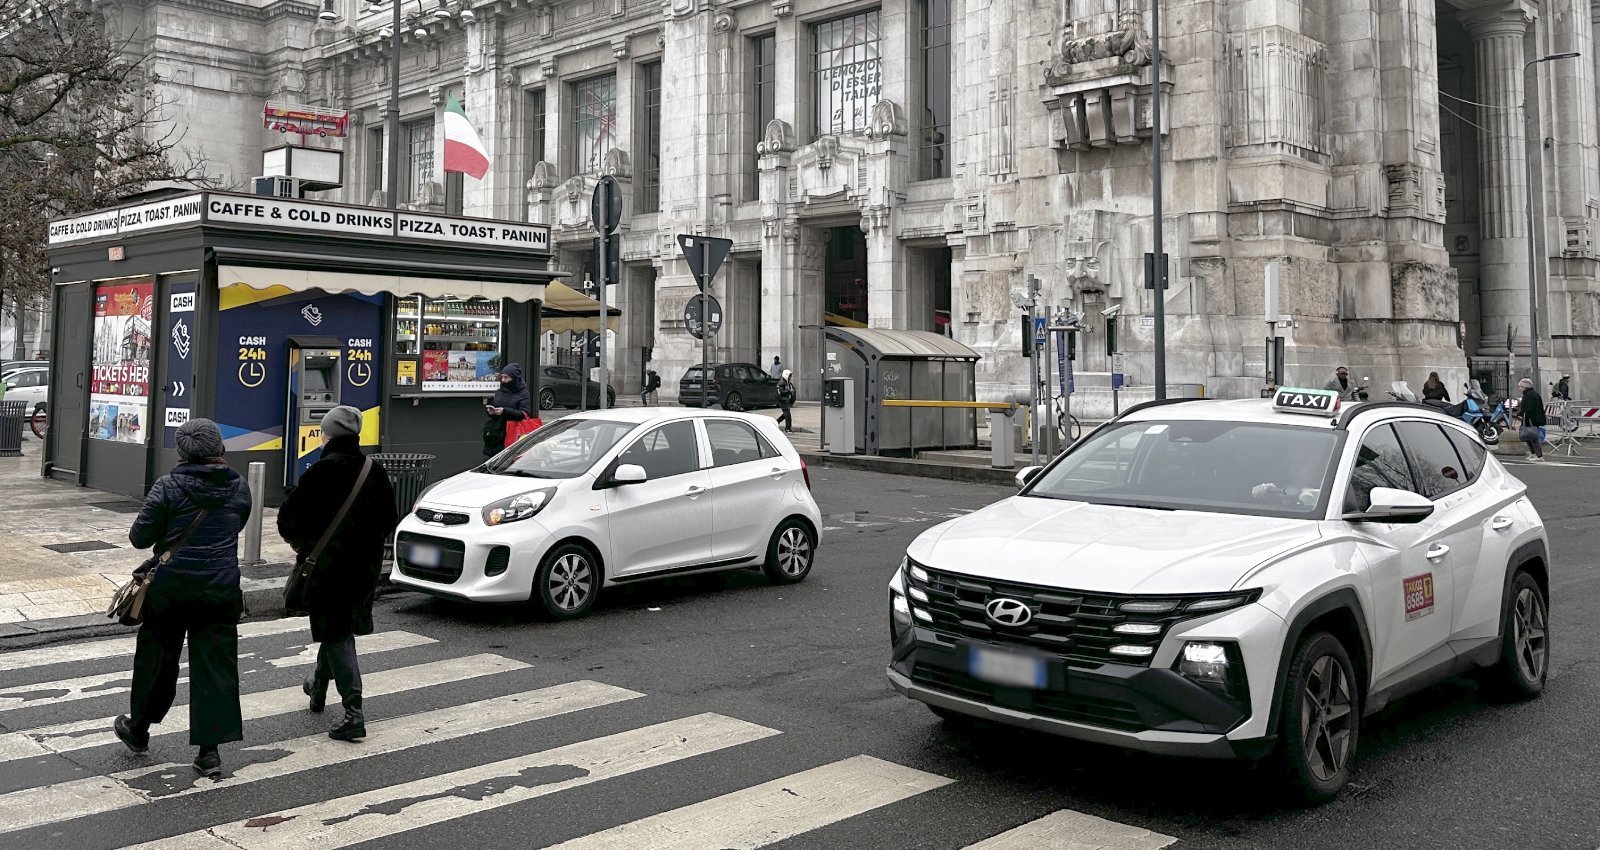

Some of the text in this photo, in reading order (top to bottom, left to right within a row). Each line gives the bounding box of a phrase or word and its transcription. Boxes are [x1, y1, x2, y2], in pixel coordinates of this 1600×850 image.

[210, 201, 392, 229] CAFFE & COLD DRINKS
[51, 218, 118, 236] CAFFE & COLD DRINKS
[400, 220, 546, 243] PIZZA, TOAST, PANINI
[173, 295, 193, 308] CASH
[239, 336, 266, 345] CASH
[348, 339, 372, 347] CASH
[238, 348, 266, 360] 24h
[348, 350, 372, 360] 24h
[93, 366, 149, 383] TICKETS HER
[1281, 393, 1327, 407] TAXI
[168, 412, 187, 422] CASH
[309, 429, 322, 437] AT
[1407, 591, 1424, 610] 8585
